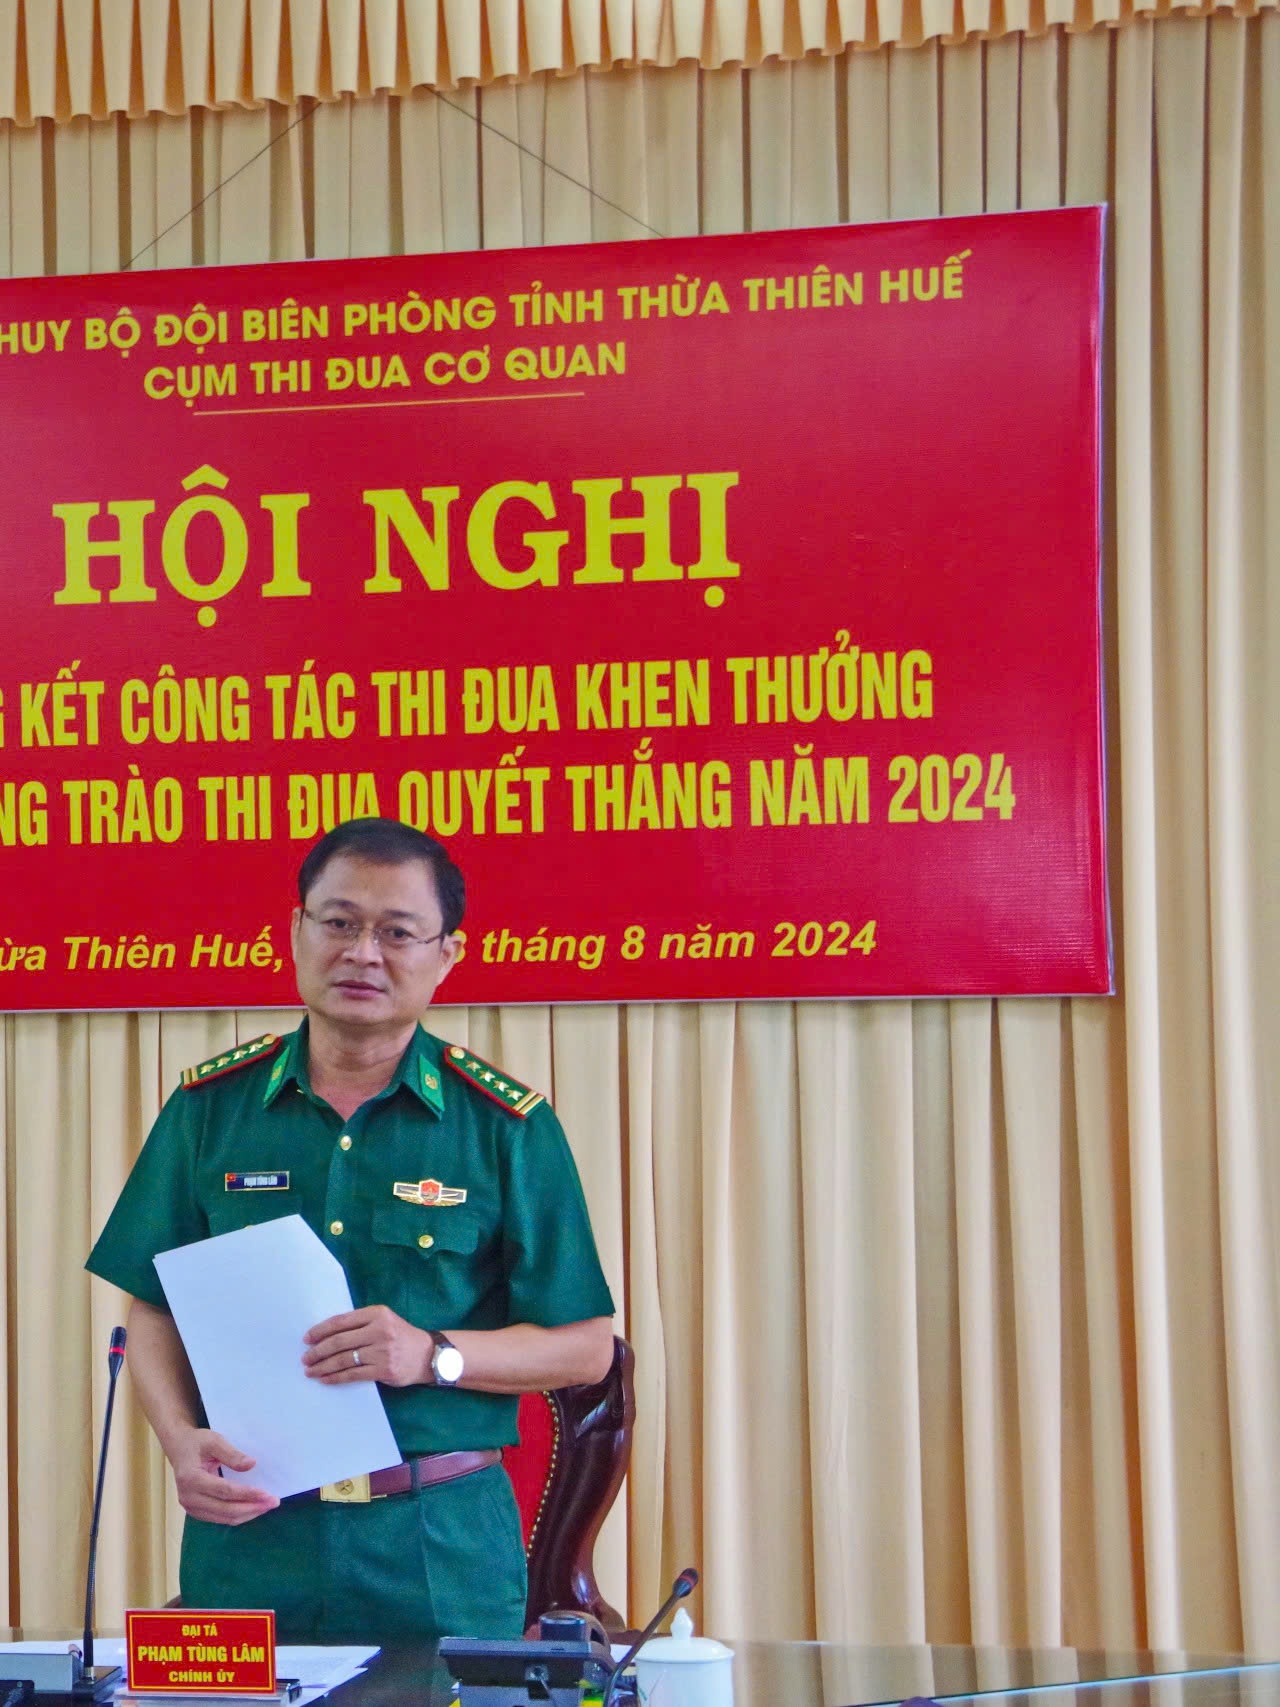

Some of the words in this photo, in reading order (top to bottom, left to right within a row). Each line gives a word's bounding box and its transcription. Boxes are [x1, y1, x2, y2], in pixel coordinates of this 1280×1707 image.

[85, 307, 141, 358] BỘ
[153, 303, 228, 354] ĐỘI
[242, 298, 329, 343] BIÊN
[344, 291, 497, 337] PHÒNG
[508, 280, 604, 327] TỈNH
[616, 274, 730, 320] THỪA
[743, 264, 863, 312] THIÊN
[880, 249, 972, 303] HUẾ
[143, 365, 237, 408] CỤM
[249, 360, 312, 394] THI
[324, 354, 411, 391] ĐUA
[424, 345, 491, 385] CƠ
[504, 341, 626, 381] QUAN
[51, 464, 312, 628] HỘI
[362, 471, 741, 608] NGHỊ
[20, 659, 105, 747] KẾT
[120, 664, 250, 745] CÔNG
[264, 659, 356, 741] TÁC
[371, 669, 446, 737] THI
[461, 665, 561, 735] ĐUA
[575, 658, 710, 730] KHEN
[726, 630, 933, 724] THƯỞNG
[62, 764, 183, 845] TRÀO
[198, 774, 272, 842] THI
[287, 772, 380, 840] ĐUA
[565, 737, 732, 831] THẮNG
[749, 743, 870, 827] NĂM
[887, 753, 1016, 823] 2024
[63, 935, 176, 970] Thiên
[190, 925, 283, 974] Huế,
[482, 925, 606, 970] tháng
[620, 925, 646, 960] 8
[659, 924, 755, 959] năm
[771, 920, 877, 957] 2024
[138, 1645, 183, 1665] PHẠM
[187, 1643, 228, 1662] TÙNG
[232, 1643, 265, 1663] LÂM
[182, 1624, 201, 1638] ĐẠI
[203, 1623, 218, 1636] TÁ
[168, 1668, 213, 1683] CHÍNH
